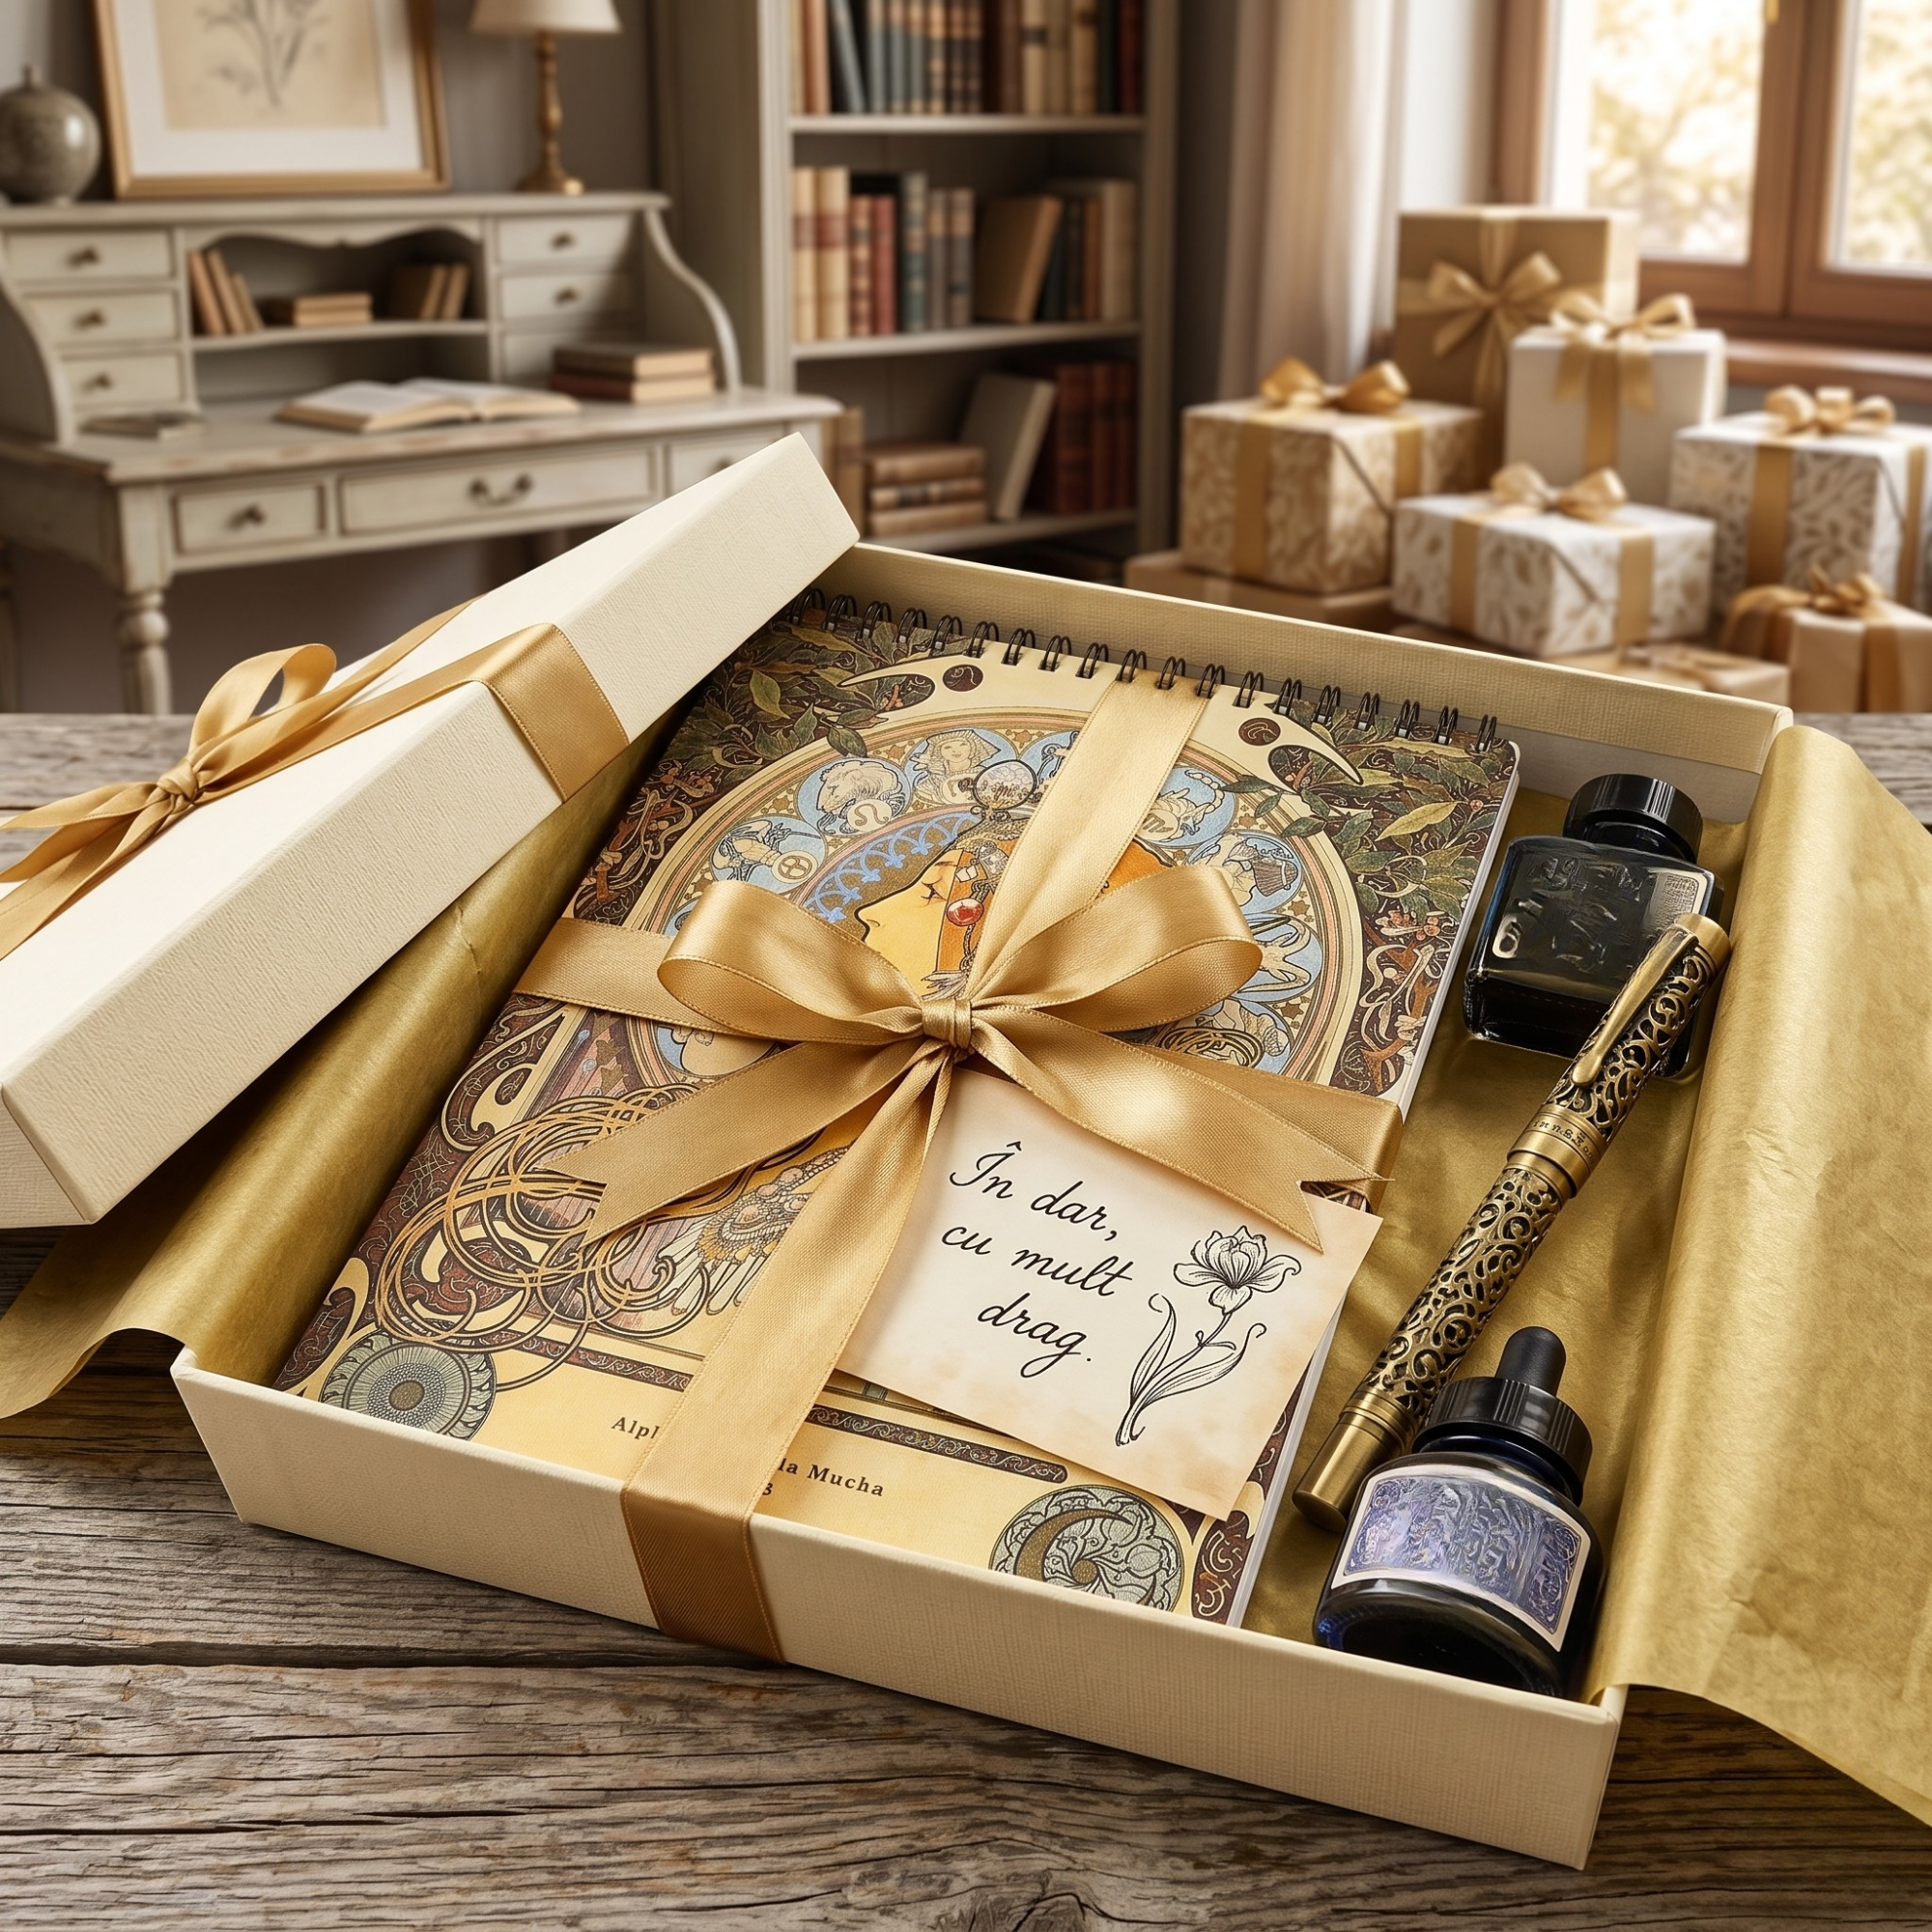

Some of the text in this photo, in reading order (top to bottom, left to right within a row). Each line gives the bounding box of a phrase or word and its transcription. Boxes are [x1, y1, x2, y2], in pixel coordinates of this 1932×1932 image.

[949, 1141, 1118, 1241] În dar,
[941, 1226, 1134, 1296] cu mult
[977, 1292, 1092, 1378] drag.
[761, 1482, 774, 1496] 3
[777, 1458, 799, 1475] la
[807, 1463, 885, 1497] Mucha
